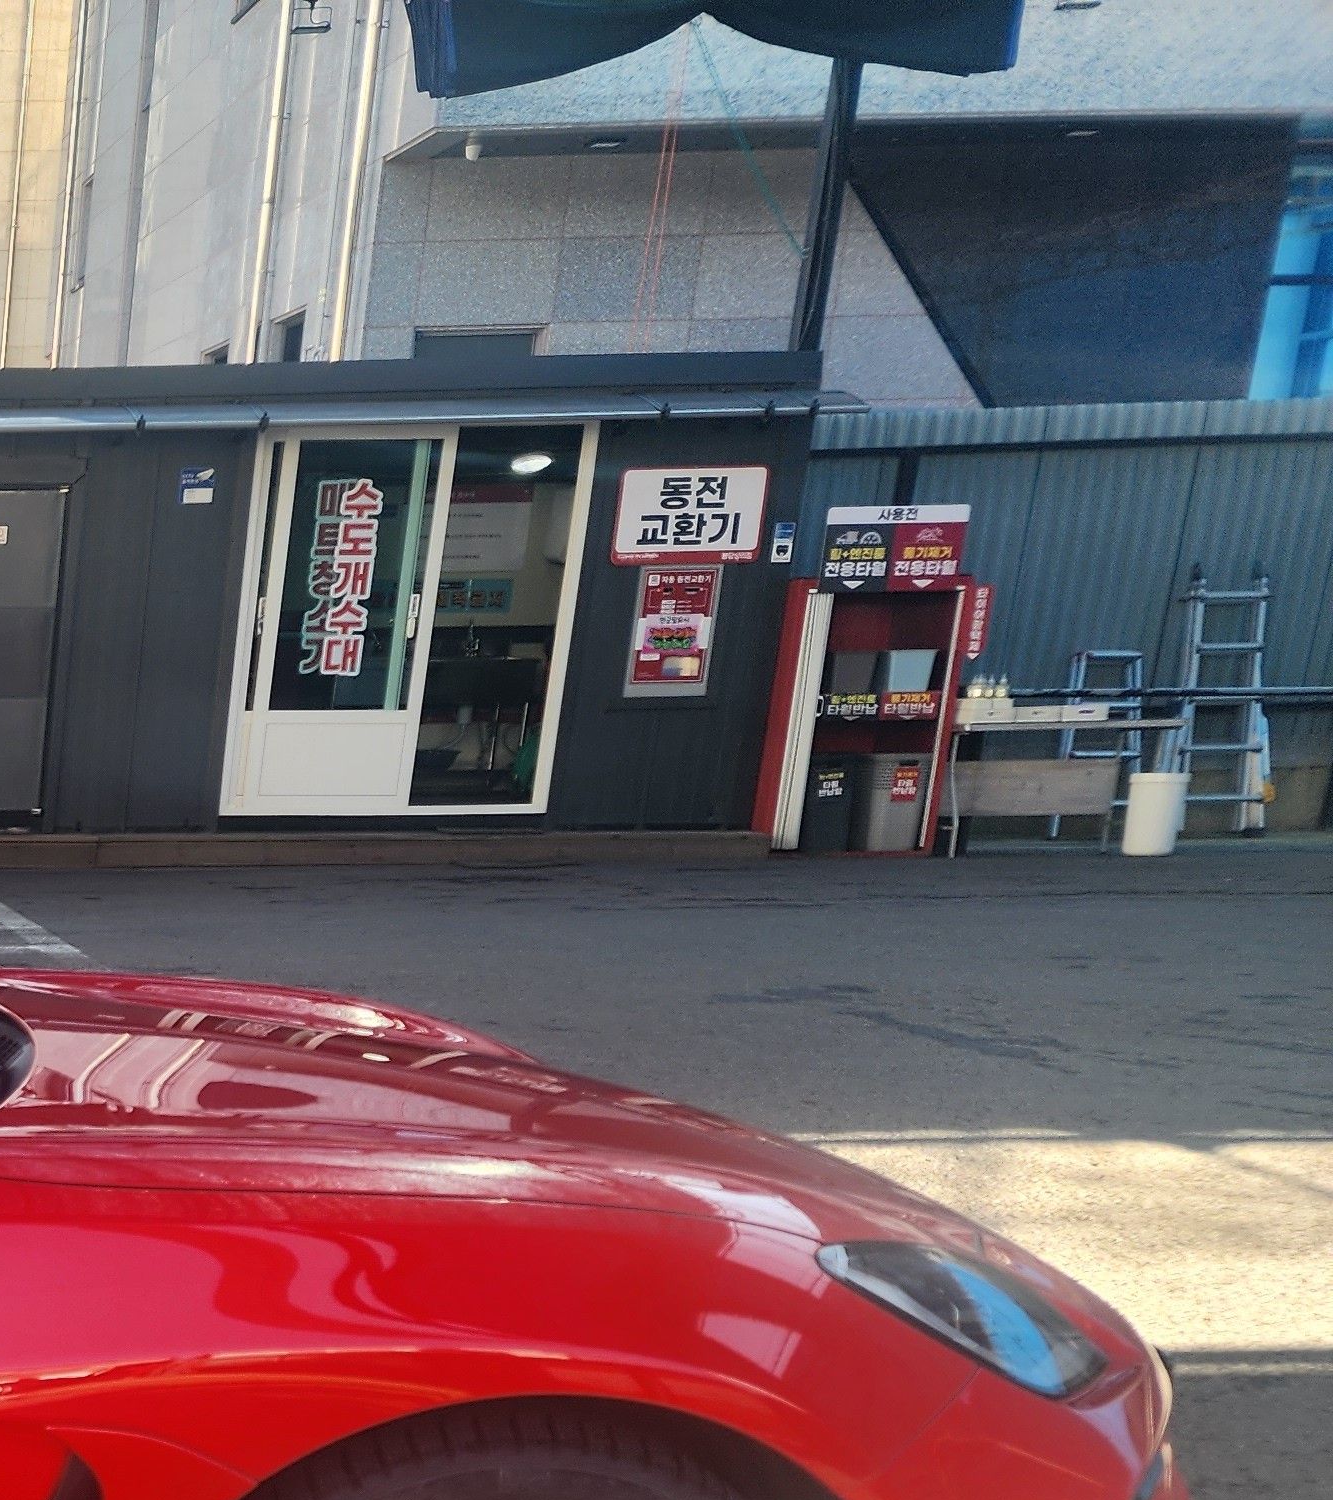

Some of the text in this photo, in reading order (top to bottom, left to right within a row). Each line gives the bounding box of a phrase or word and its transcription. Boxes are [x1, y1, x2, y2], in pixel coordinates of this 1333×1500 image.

[660, 476, 728, 509] 동전
[878, 507, 919, 521] 사용전
[636, 513, 741, 546] 교환기
[903, 547, 953, 559] 물기제거
[824, 561, 887, 577] 전용타월
[894, 560, 958, 576] 전용타월
[323, 481, 380, 673] 수도개수대
[661, 574, 711, 584] 자동 동전교환기
[827, 704, 878, 715] 타월반납
[884, 703, 935, 714] 타월반납
